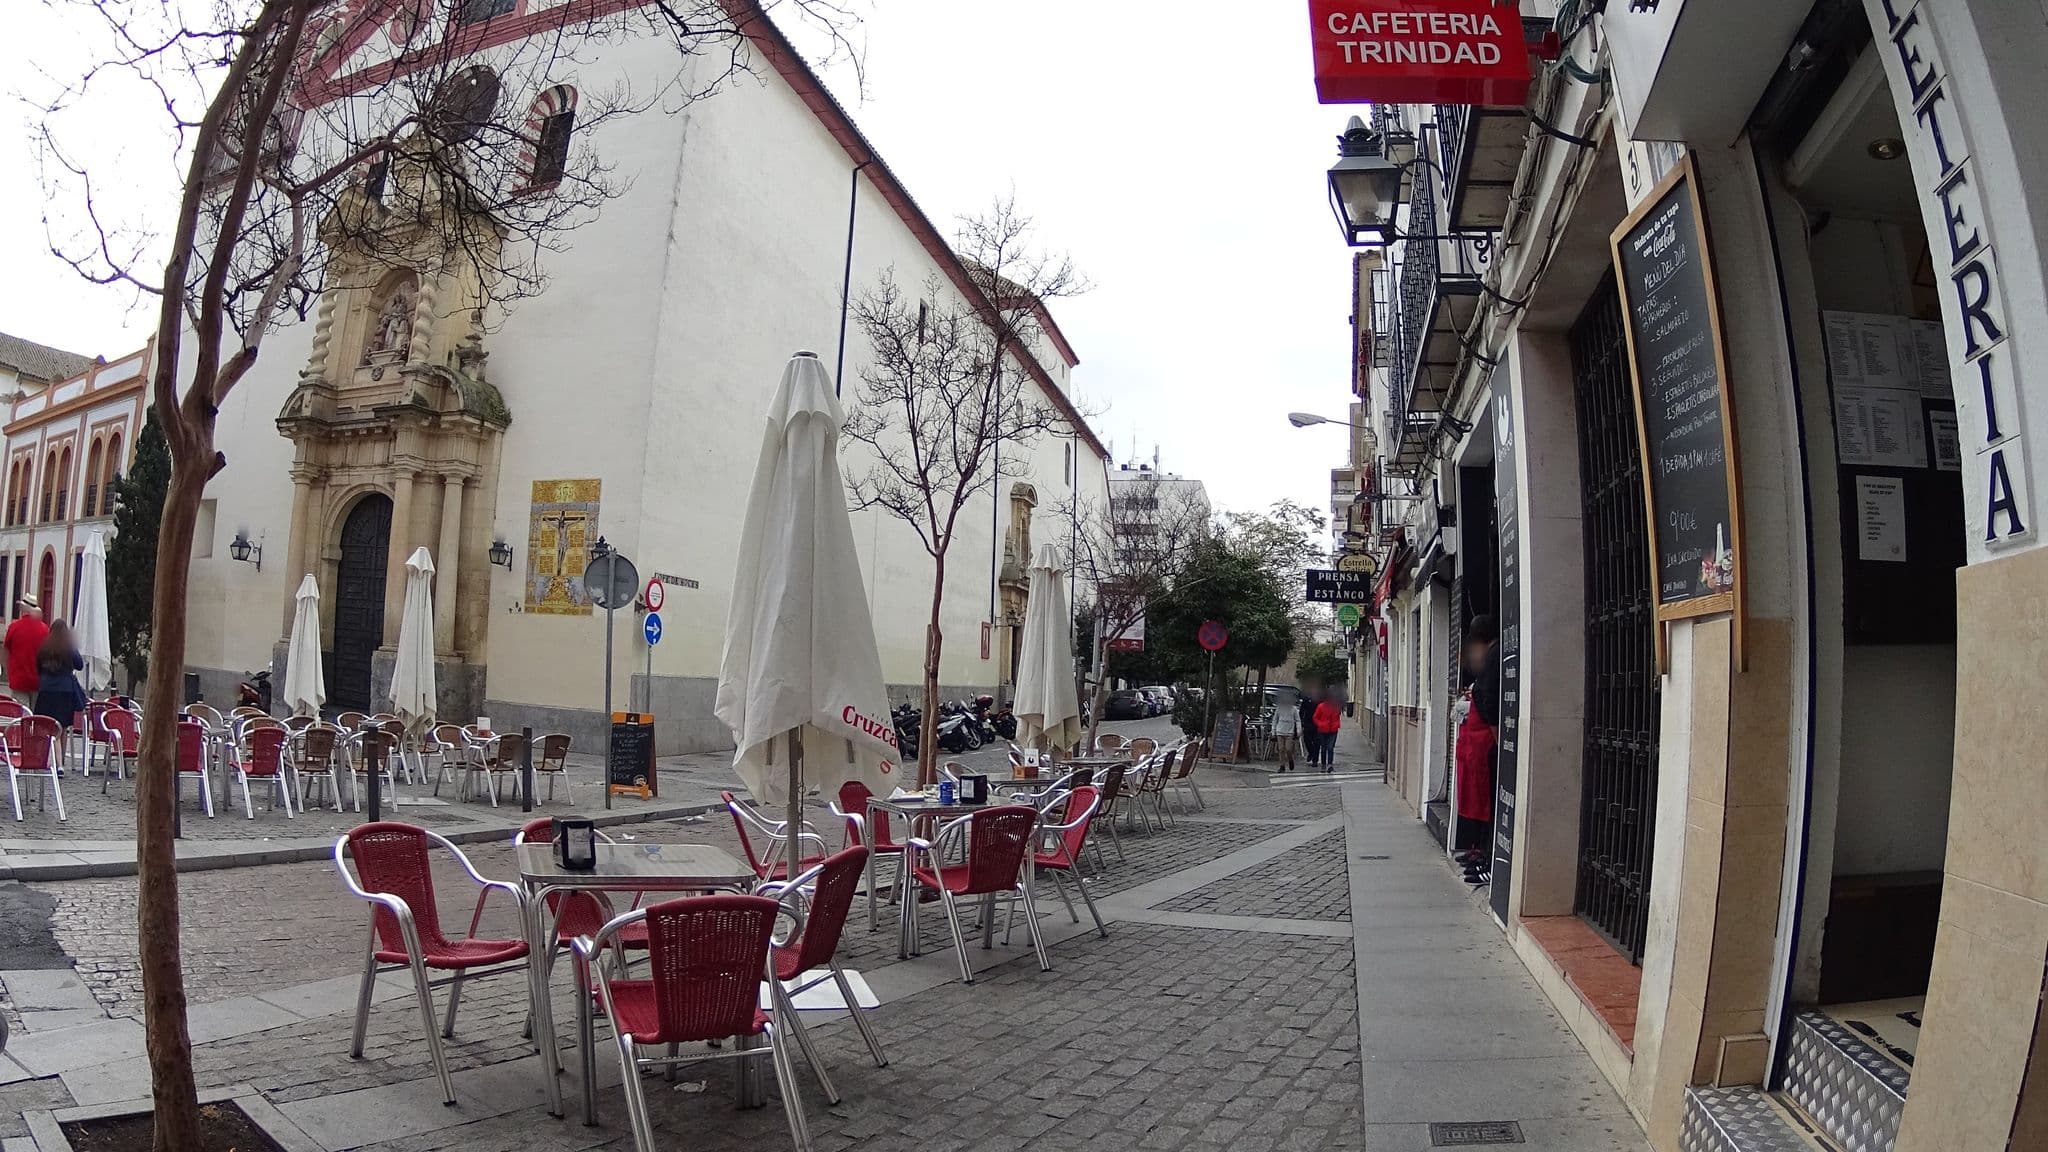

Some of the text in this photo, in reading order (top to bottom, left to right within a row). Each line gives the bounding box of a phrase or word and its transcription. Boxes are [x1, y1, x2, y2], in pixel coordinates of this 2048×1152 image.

[1328, 12, 1502, 36] CAFETERIA
[1337, 41, 1501, 65] TRINIDAD
[1666, 202, 1680, 218] tapa
[1643, 245, 1653, 258] con
[1661, 259, 1675, 278] DEL
[1882, 0, 2026, 541] ETERIA
[1343, 559, 1372, 567] Estrella
[1318, 572, 1360, 582] PRENSA
[1336, 582, 1342, 590] Y
[1314, 589, 1364, 600] ESTANCO
[842, 705, 899, 750] Cruzca
